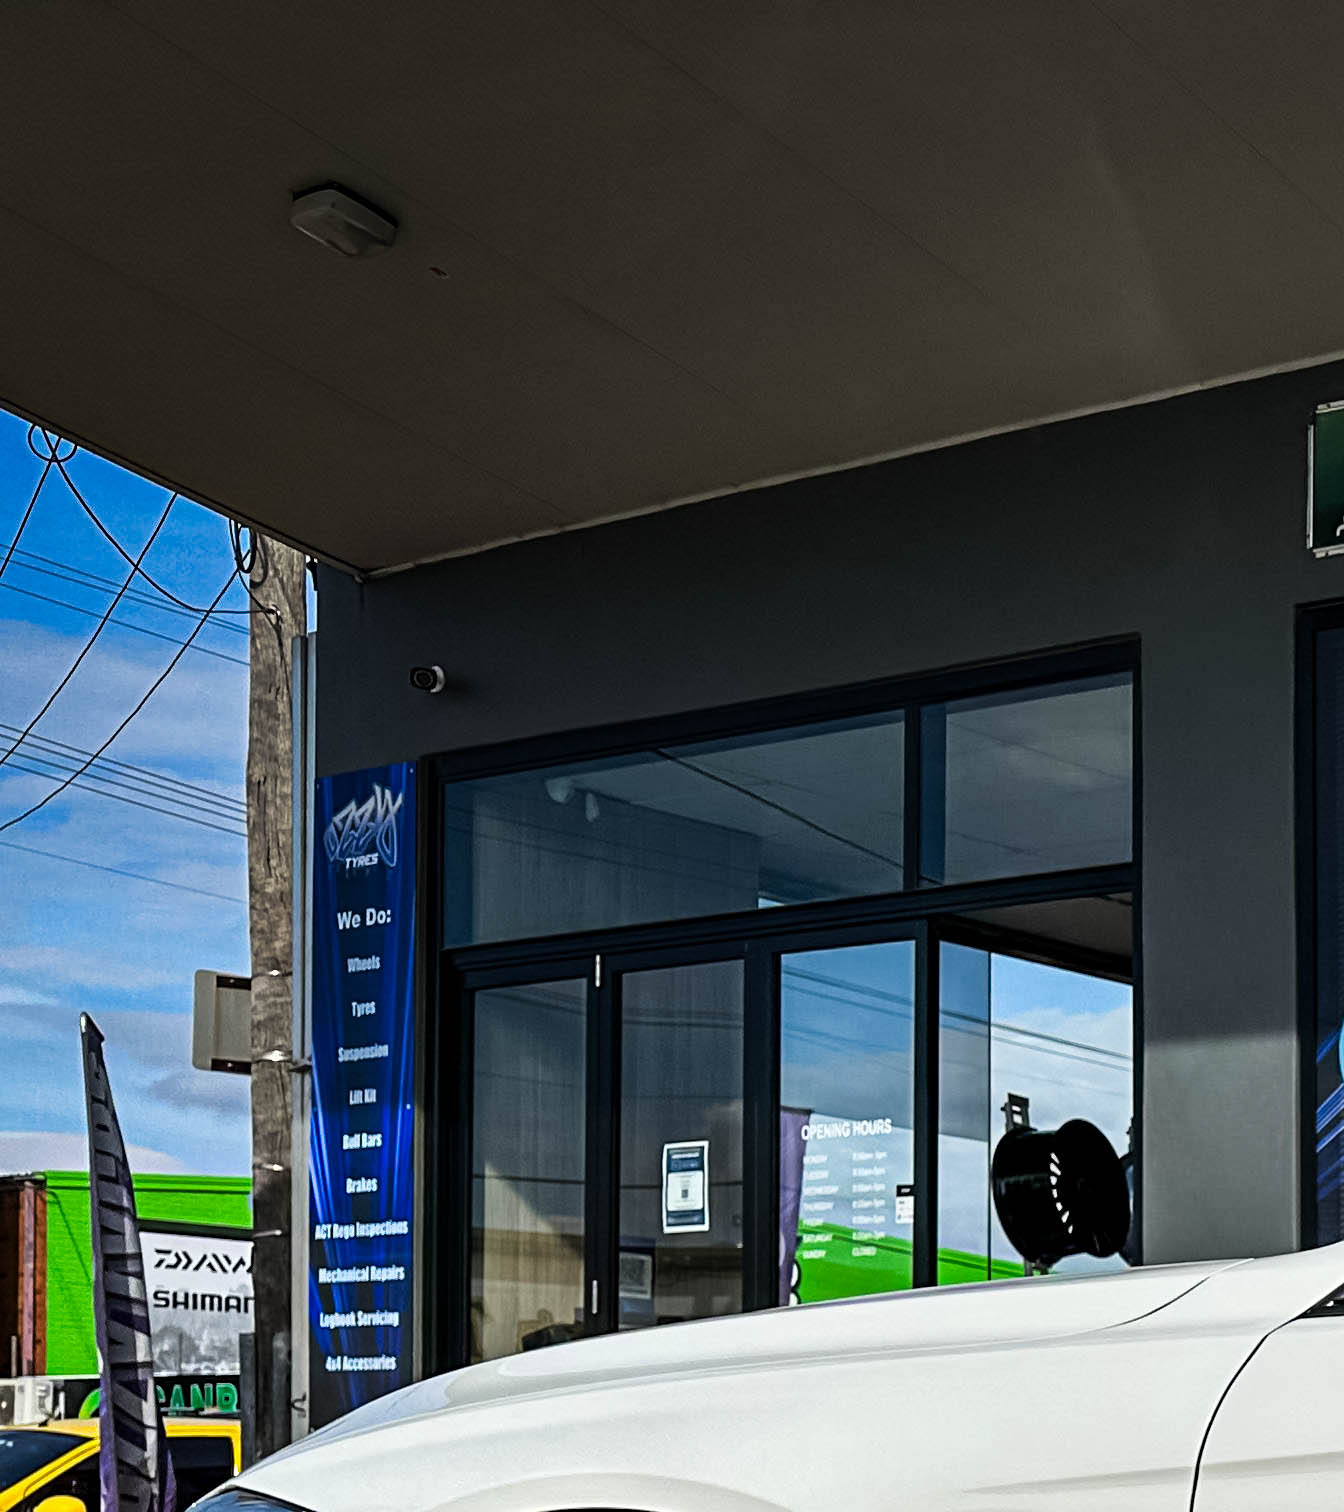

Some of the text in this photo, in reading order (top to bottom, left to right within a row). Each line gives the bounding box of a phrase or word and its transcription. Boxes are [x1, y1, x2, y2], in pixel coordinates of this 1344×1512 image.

[323, 782, 403, 868] OZZY
[345, 853, 379, 870] TYRES
[337, 908, 391, 930] We Do:
[347, 955, 381, 973] Wheels
[352, 1001, 376, 1017] Tyres
[338, 1044, 389, 1062] Suspension
[350, 1088, 377, 1105] Lift Kit
[801, 1118, 892, 1140] OPENING HOURS
[342, 1132, 382, 1150] Bull Bars
[346, 1177, 378, 1194] Brakes
[315, 1219, 408, 1240] ACT Rego Inspections
[318, 1264, 405, 1284] Mechanical Repairs
[319, 1310, 400, 1329] Logbook Servicing
[325, 1354, 397, 1371] 4x4 Accessories
